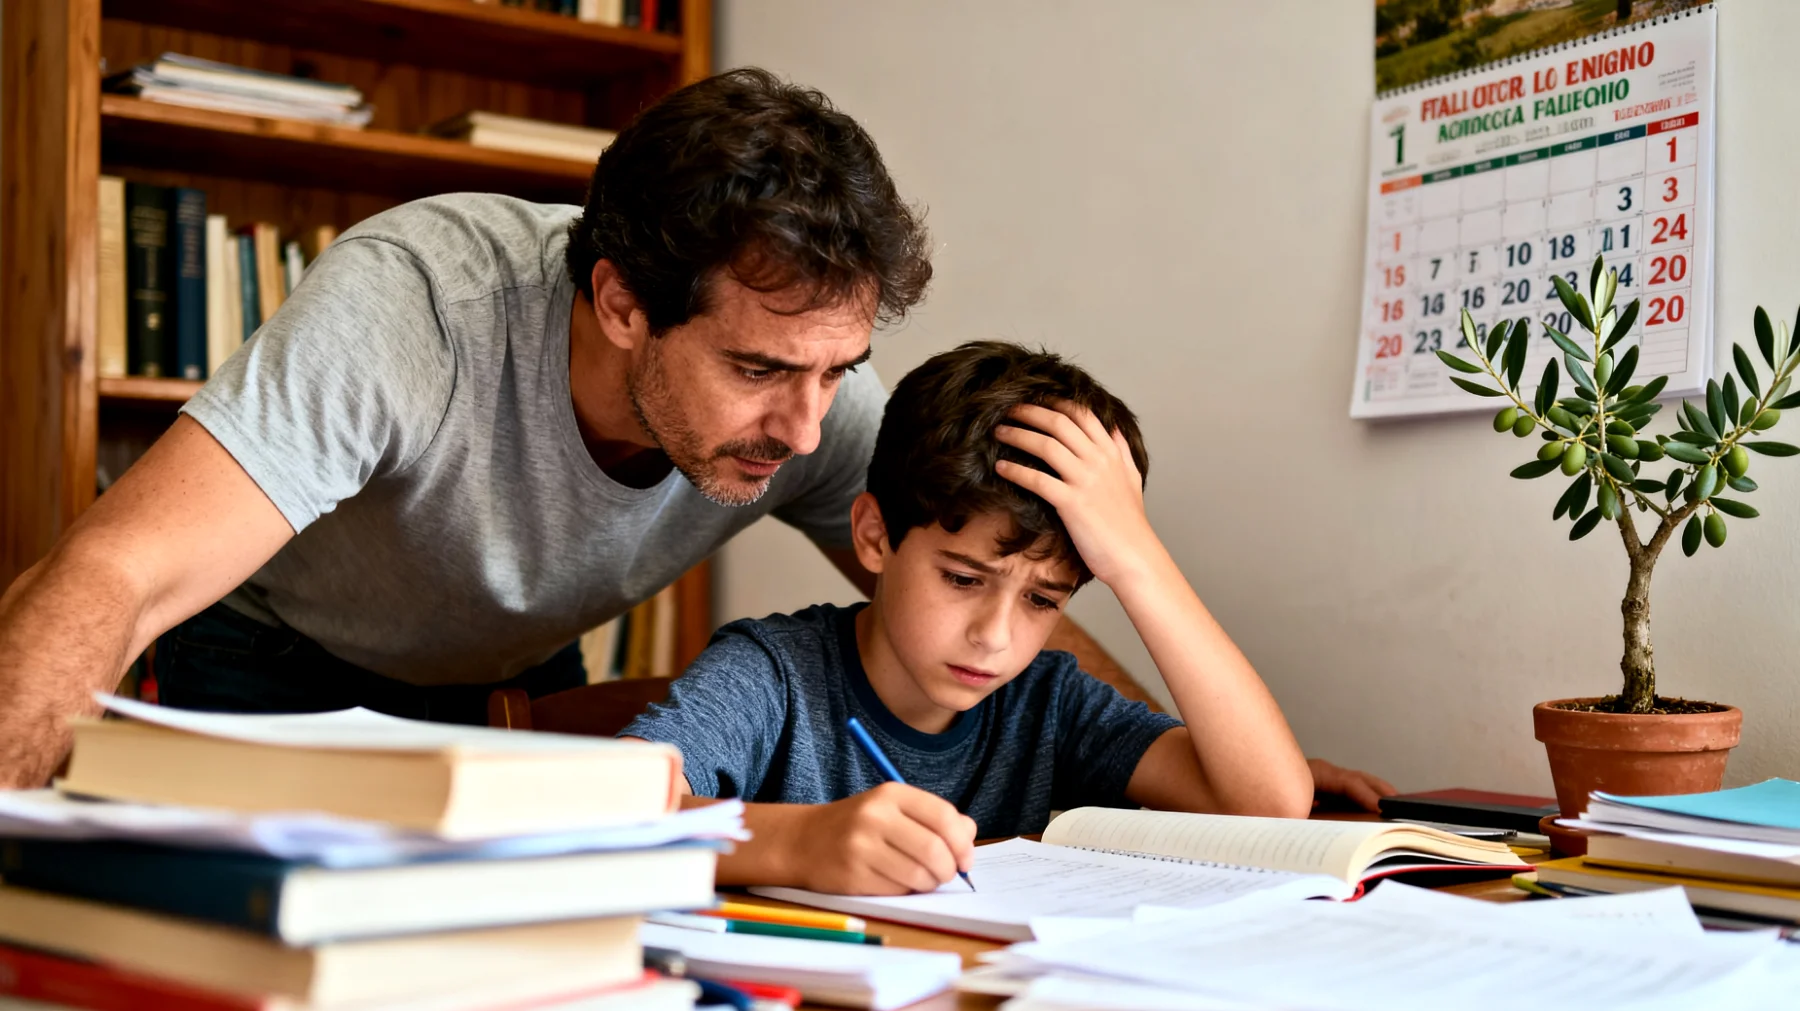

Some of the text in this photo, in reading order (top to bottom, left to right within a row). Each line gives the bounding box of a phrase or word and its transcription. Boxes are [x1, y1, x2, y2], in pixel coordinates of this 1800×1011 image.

[1666, 136, 1677, 163] 1
[1617, 186, 1633, 211] 3
[1662, 176, 1679, 203] 3
[1506, 242, 1532, 267] 10
[1548, 234, 1576, 261] 18
[1650, 213, 1688, 245] 24
[1501, 278, 1531, 305] 20
[1647, 254, 1687, 286] 20
[1375, 334, 1403, 359] 20
[1413, 328, 1443, 354] 23
[1645, 294, 1685, 327] 20
